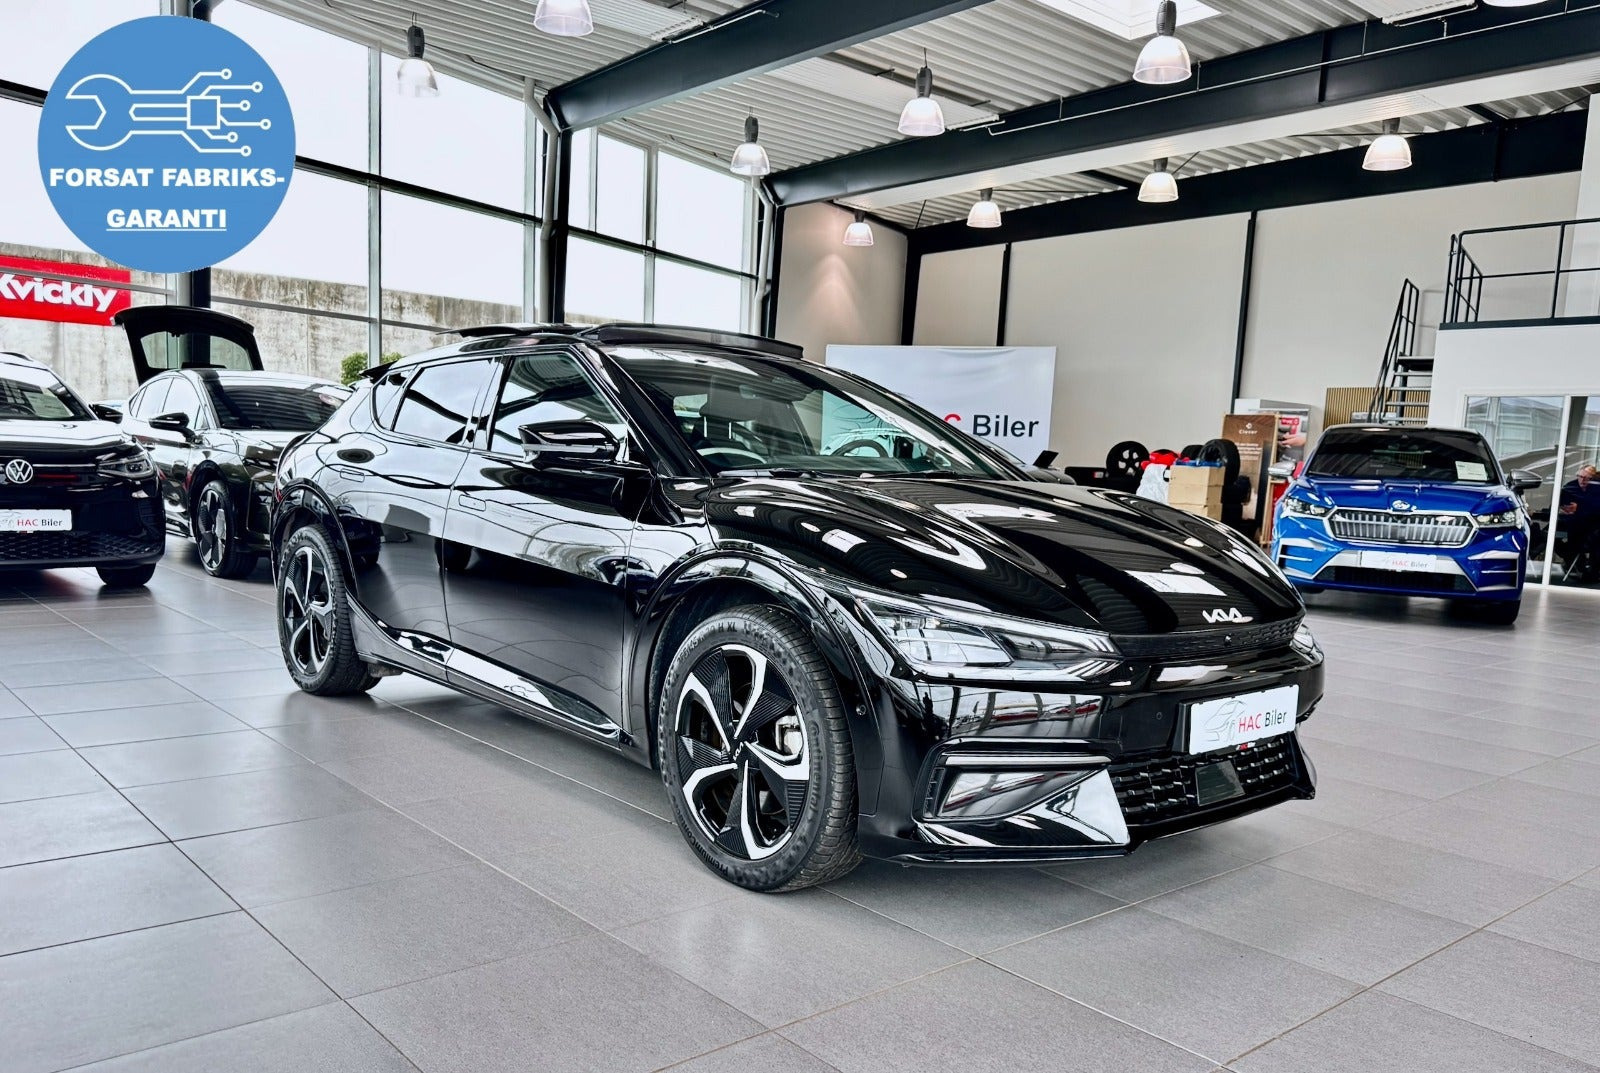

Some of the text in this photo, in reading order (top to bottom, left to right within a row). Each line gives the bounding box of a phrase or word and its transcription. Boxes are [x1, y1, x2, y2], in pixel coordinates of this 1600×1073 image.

[972, 414, 1039, 437] Biler
[17, 518, 63, 527] HAC Biler
[1391, 559, 1408, 567] HAC
[1238, 707, 1287, 733] HAC Biler
